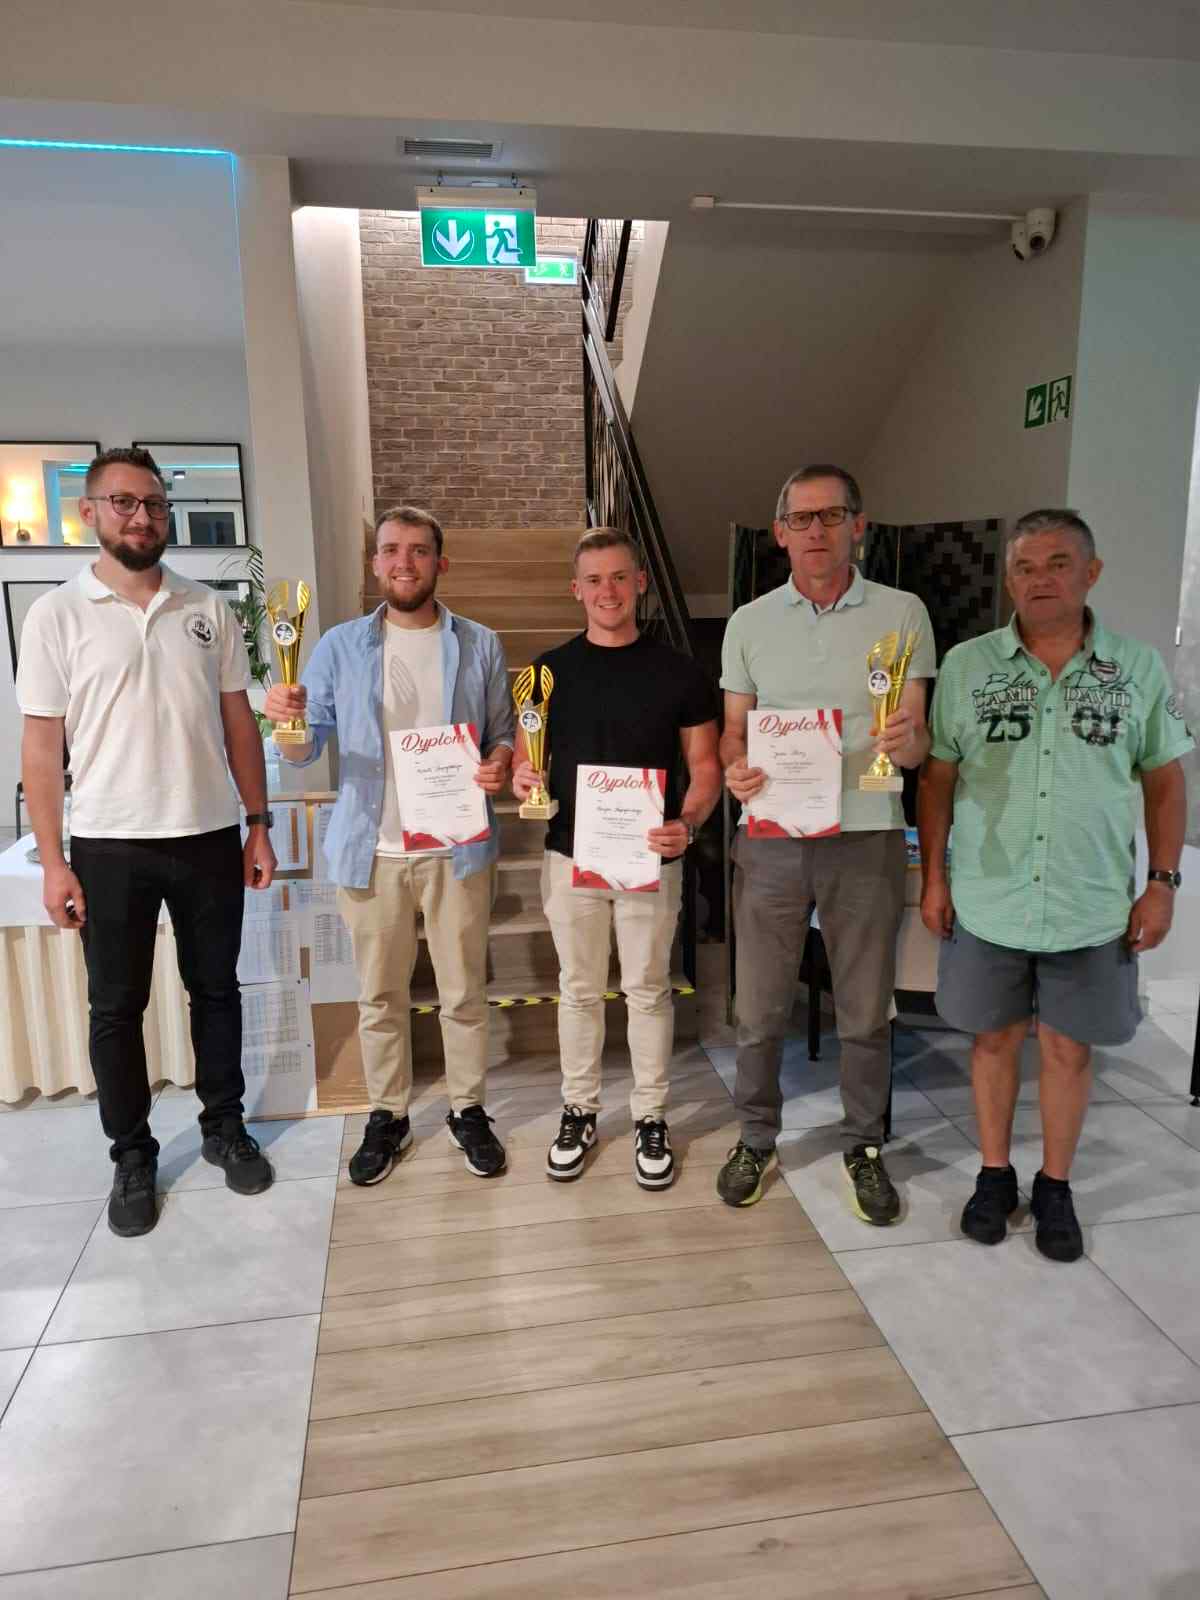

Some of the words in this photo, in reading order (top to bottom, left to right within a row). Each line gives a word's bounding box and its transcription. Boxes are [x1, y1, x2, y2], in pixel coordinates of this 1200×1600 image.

[760, 714, 831, 738] Dyplom
[401, 731, 465, 755] Dyplom
[587, 770, 654, 793] Dyplom
